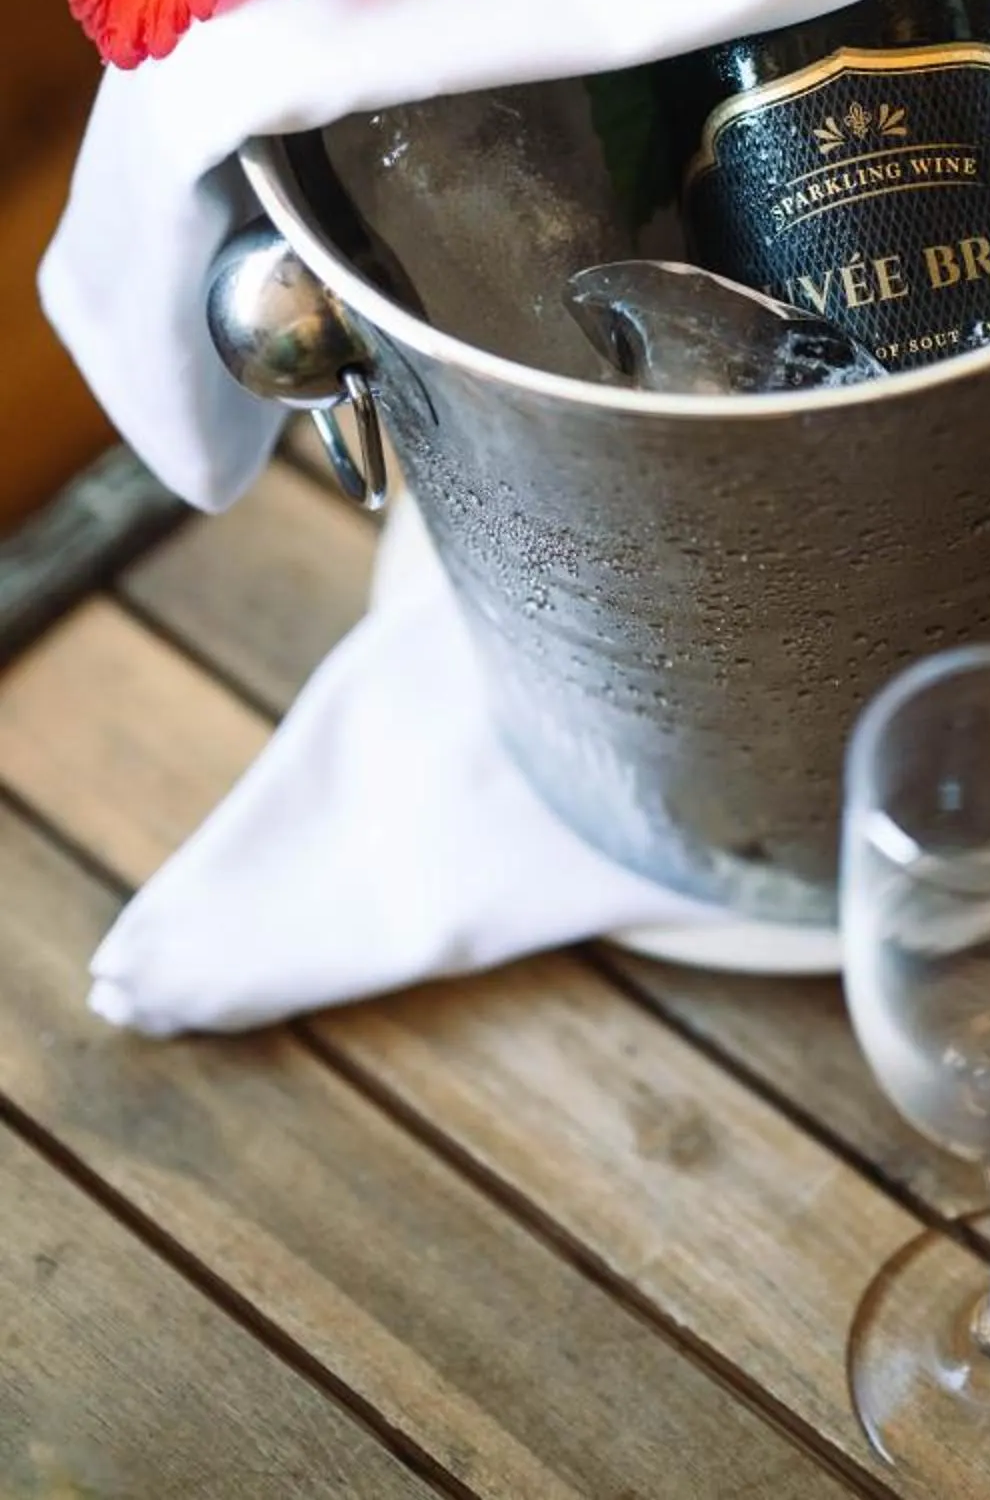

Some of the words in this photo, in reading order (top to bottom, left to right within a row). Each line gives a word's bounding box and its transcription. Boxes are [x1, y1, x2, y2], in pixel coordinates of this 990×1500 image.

[770, 161, 901, 222] SPARKLING
[910, 156, 978, 176] WINE
[908, 329, 962, 353] SOUT
